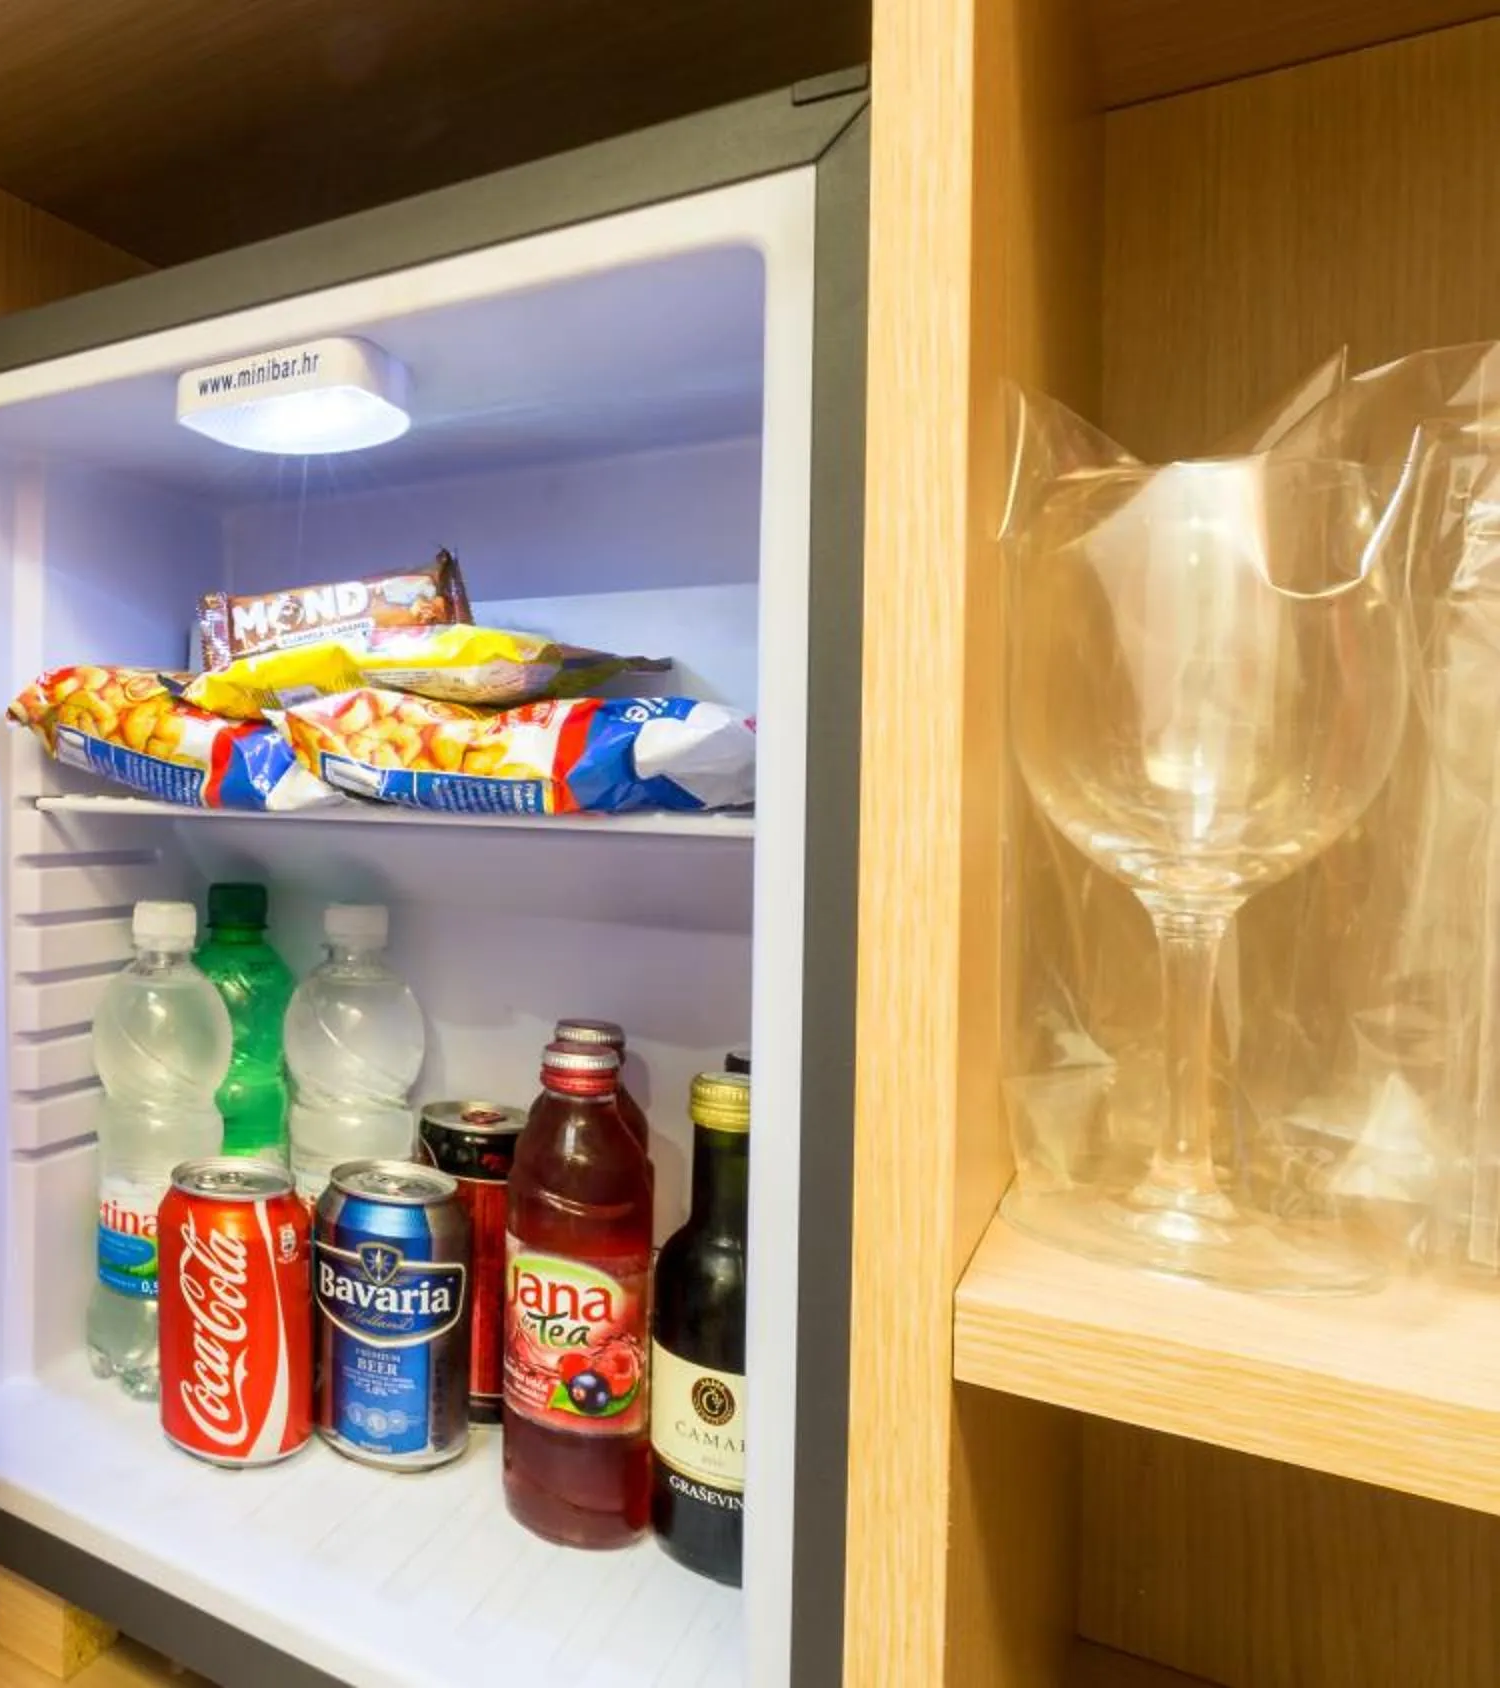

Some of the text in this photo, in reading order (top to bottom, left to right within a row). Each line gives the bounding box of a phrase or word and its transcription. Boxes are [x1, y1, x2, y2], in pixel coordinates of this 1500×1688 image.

[197, 350, 321, 397] www.minibar.hr
[319, 1259, 452, 1316] Bavaria
[510, 1263, 615, 1324] Jana
[179, 1207, 249, 1446] Coca-Cola
[527, 1310, 591, 1348] Tea
[356, 1356, 398, 1377] BEER
